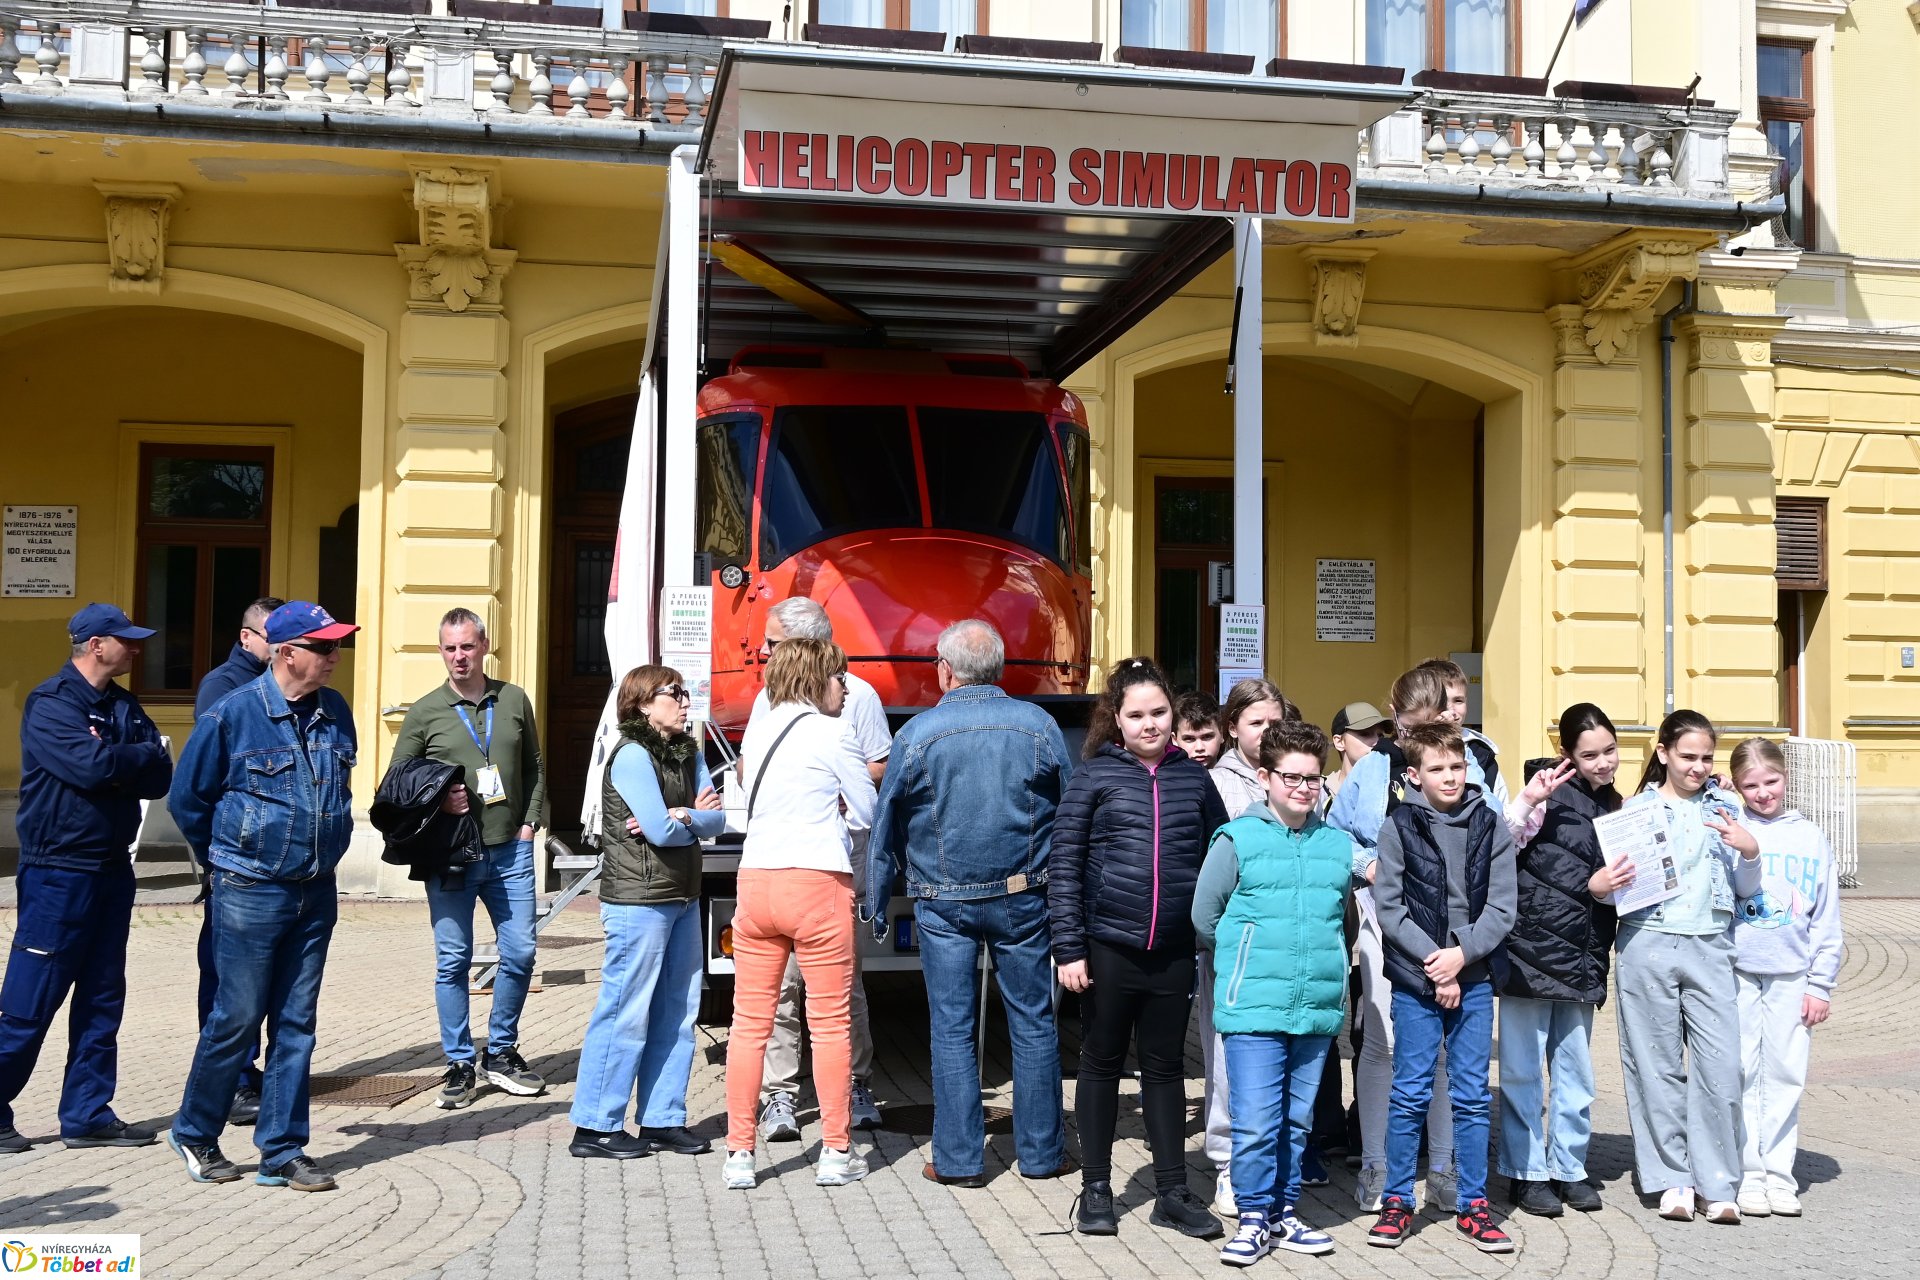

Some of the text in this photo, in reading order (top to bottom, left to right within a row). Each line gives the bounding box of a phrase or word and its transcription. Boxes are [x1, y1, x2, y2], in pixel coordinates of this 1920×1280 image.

[743, 129, 1352, 218] HELICOPTER SIMULATOR
[23, 547, 71, 555] ÉVFORDULÓJA
[1761, 853, 1820, 903] TCH
